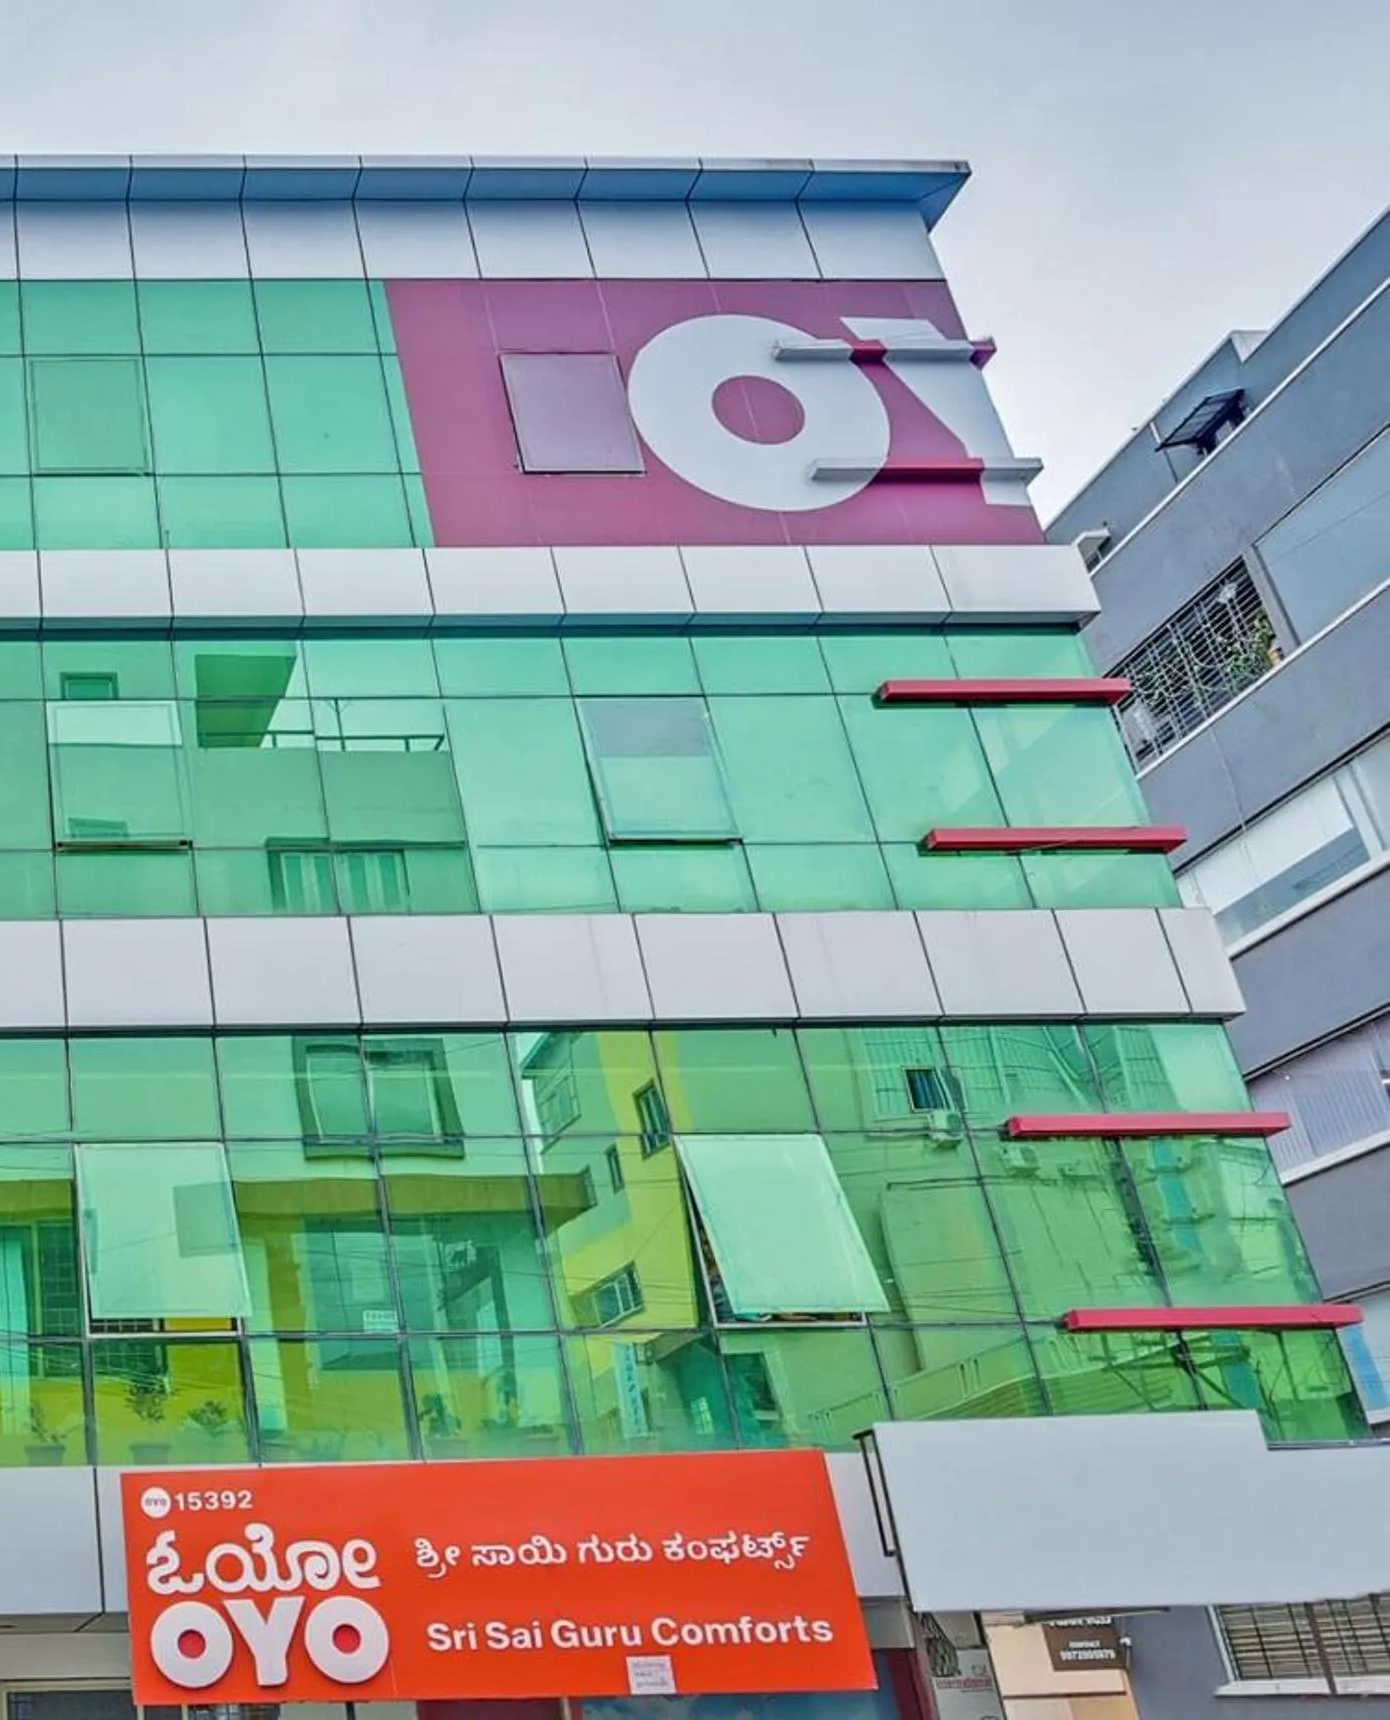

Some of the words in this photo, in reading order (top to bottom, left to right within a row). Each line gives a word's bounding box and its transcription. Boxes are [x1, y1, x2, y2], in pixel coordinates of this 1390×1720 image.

[175, 1490, 253, 1511] 15392
[146, 1523, 381, 1595] ಓಯೋ
[415, 1538, 460, 1578] ಶ್ರೀ
[471, 1534, 567, 1566] ಸಾಯಿ
[577, 1533, 654, 1564] ಗುರು
[150, 1595, 390, 1689] OYO
[426, 1622, 478, 1651] Sri
[485, 1620, 543, 1649] Sai
[550, 1619, 643, 1649] Guru
[651, 1615, 834, 1646] Comforts
